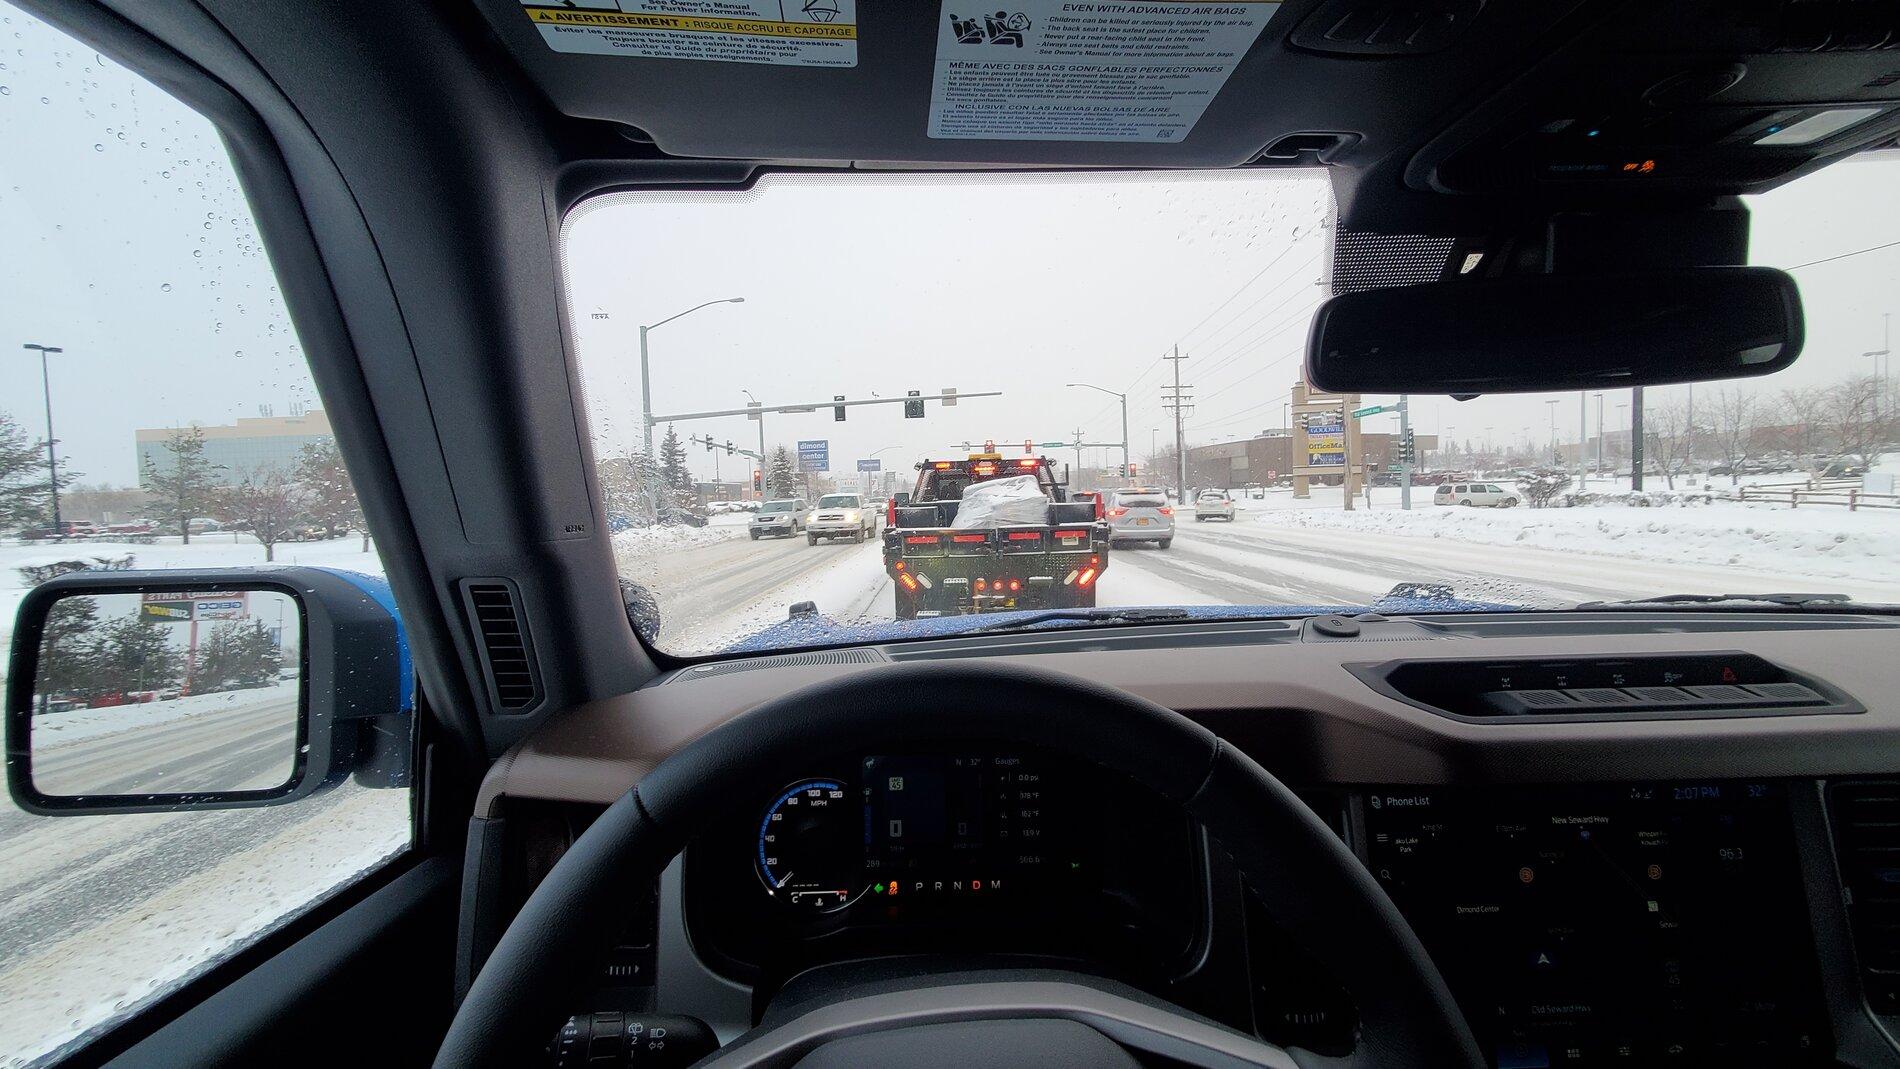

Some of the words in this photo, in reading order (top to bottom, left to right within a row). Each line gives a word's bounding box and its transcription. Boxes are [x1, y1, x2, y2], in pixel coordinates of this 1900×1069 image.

[660, 5, 698, 13] Further
[700, 8, 761, 17] Information.
[714, 1, 750, 10] Manual
[1062, 4, 1095, 12] EVEN
[1097, 5, 1126, 13] WITH
[1127, 6, 1191, 14] ADVANCED
[1193, 7, 1212, 15] AIR
[1213, 7, 1247, 15] BAGS
[555, 13, 680, 26] AVERTISSEMENT
[693, 20, 734, 31] RISQUE
[737, 23, 774, 32] ACCRU
[777, 26, 791, 34] DE
[794, 27, 851, 36] CAPOTAGE
[554, 25, 584, 34] Éviter
[605, 30, 667, 38] manoeuvres
[669, 33, 714, 42] brusques
[602, 35, 645, 44] Toujours
[648, 37, 686, 46] boucler
[702, 40, 744, 48] ceinture
[612, 41, 659, 50] Consulter
[673, 44, 702, 52] Guide
[705, 45, 717, 53] du
[1041, 41, 1067, 49] Always
[654, 49, 672, 58] plus
[674, 51, 705, 60] amples
[949, 61, 980, 69] MÊME
[1068, 65, 1138, 73] GONFLABLES
[800, 442, 826, 450] dimond
[829, 791, 843, 799] 120
[1674, 787, 1698, 800] 2:07
[1701, 786, 1720, 799] PM
[1386, 796, 1413, 806] Phone
[1414, 796, 1430, 806] List
[1552, 816, 1567, 824] New
[916, 883, 923, 891] P
[935, 882, 943, 891] R
[954, 881, 962, 890] N
[972, 881, 981, 890] D
[991, 880, 1001, 890] M
[631, 1036, 638, 1045] 2
